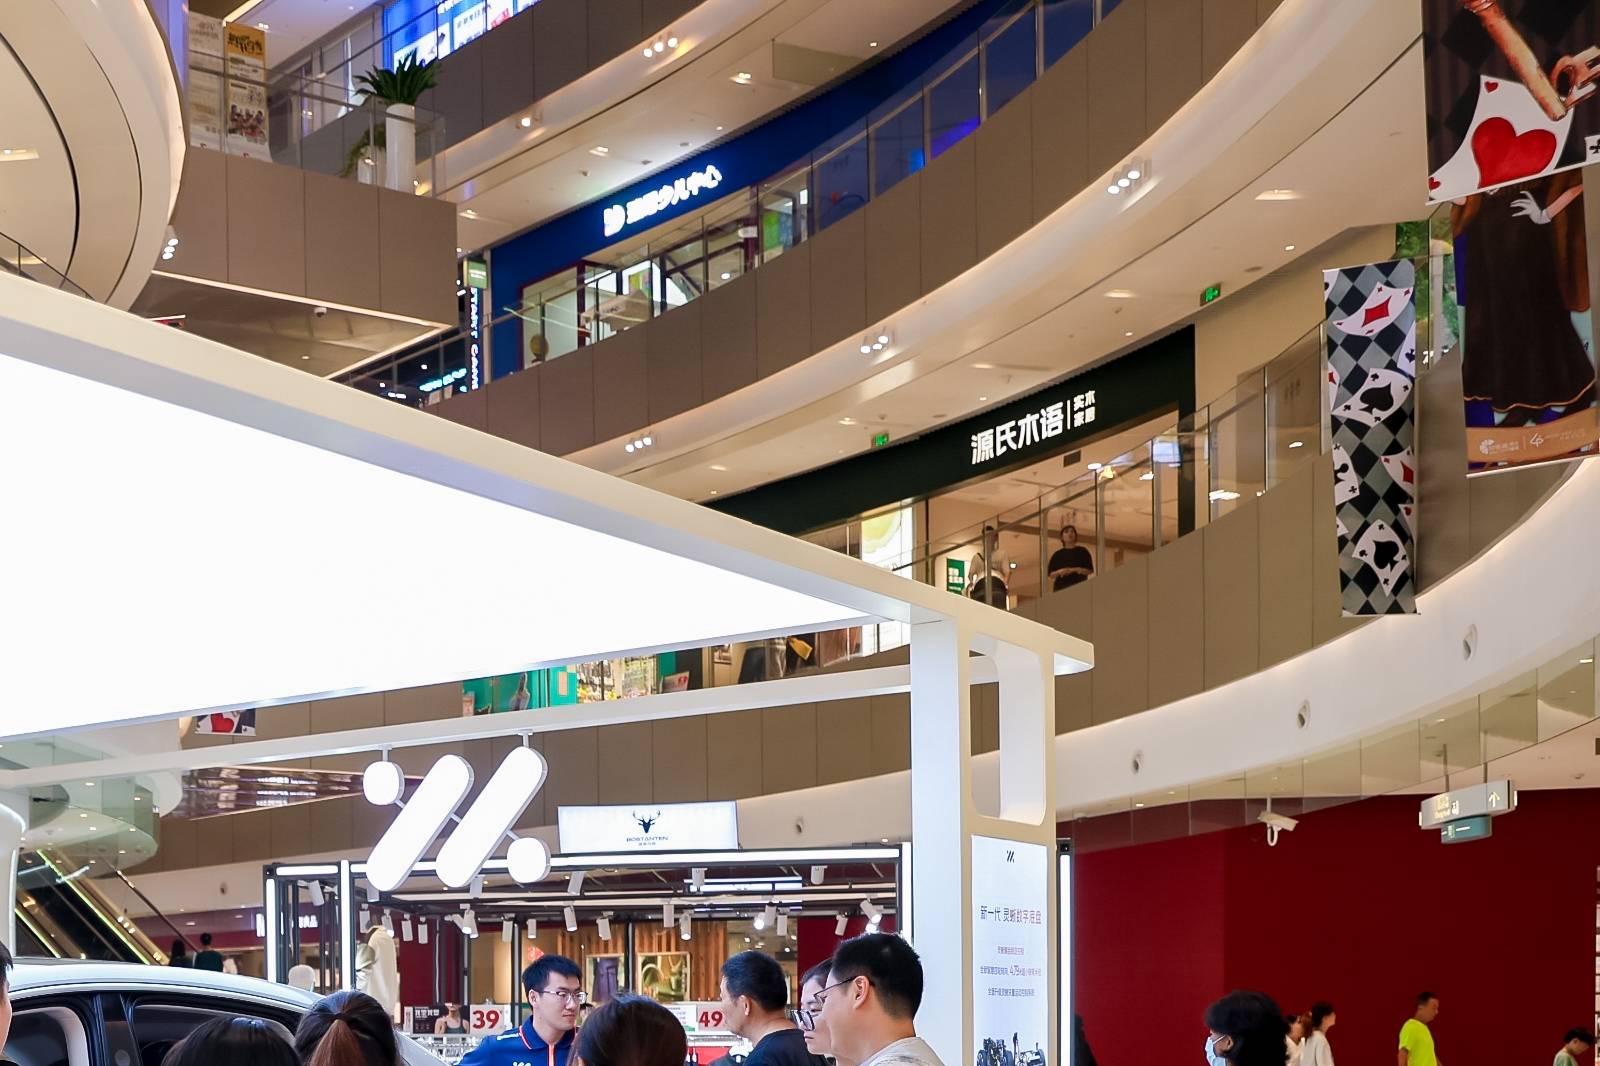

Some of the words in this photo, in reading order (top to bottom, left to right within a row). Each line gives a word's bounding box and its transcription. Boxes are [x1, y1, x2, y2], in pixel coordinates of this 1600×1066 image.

[1073, 390, 1096, 411] 实木
[971, 402, 1064, 465] 源氏木语
[472, 1009, 500, 1029] 39
[698, 1010, 723, 1028] 49
